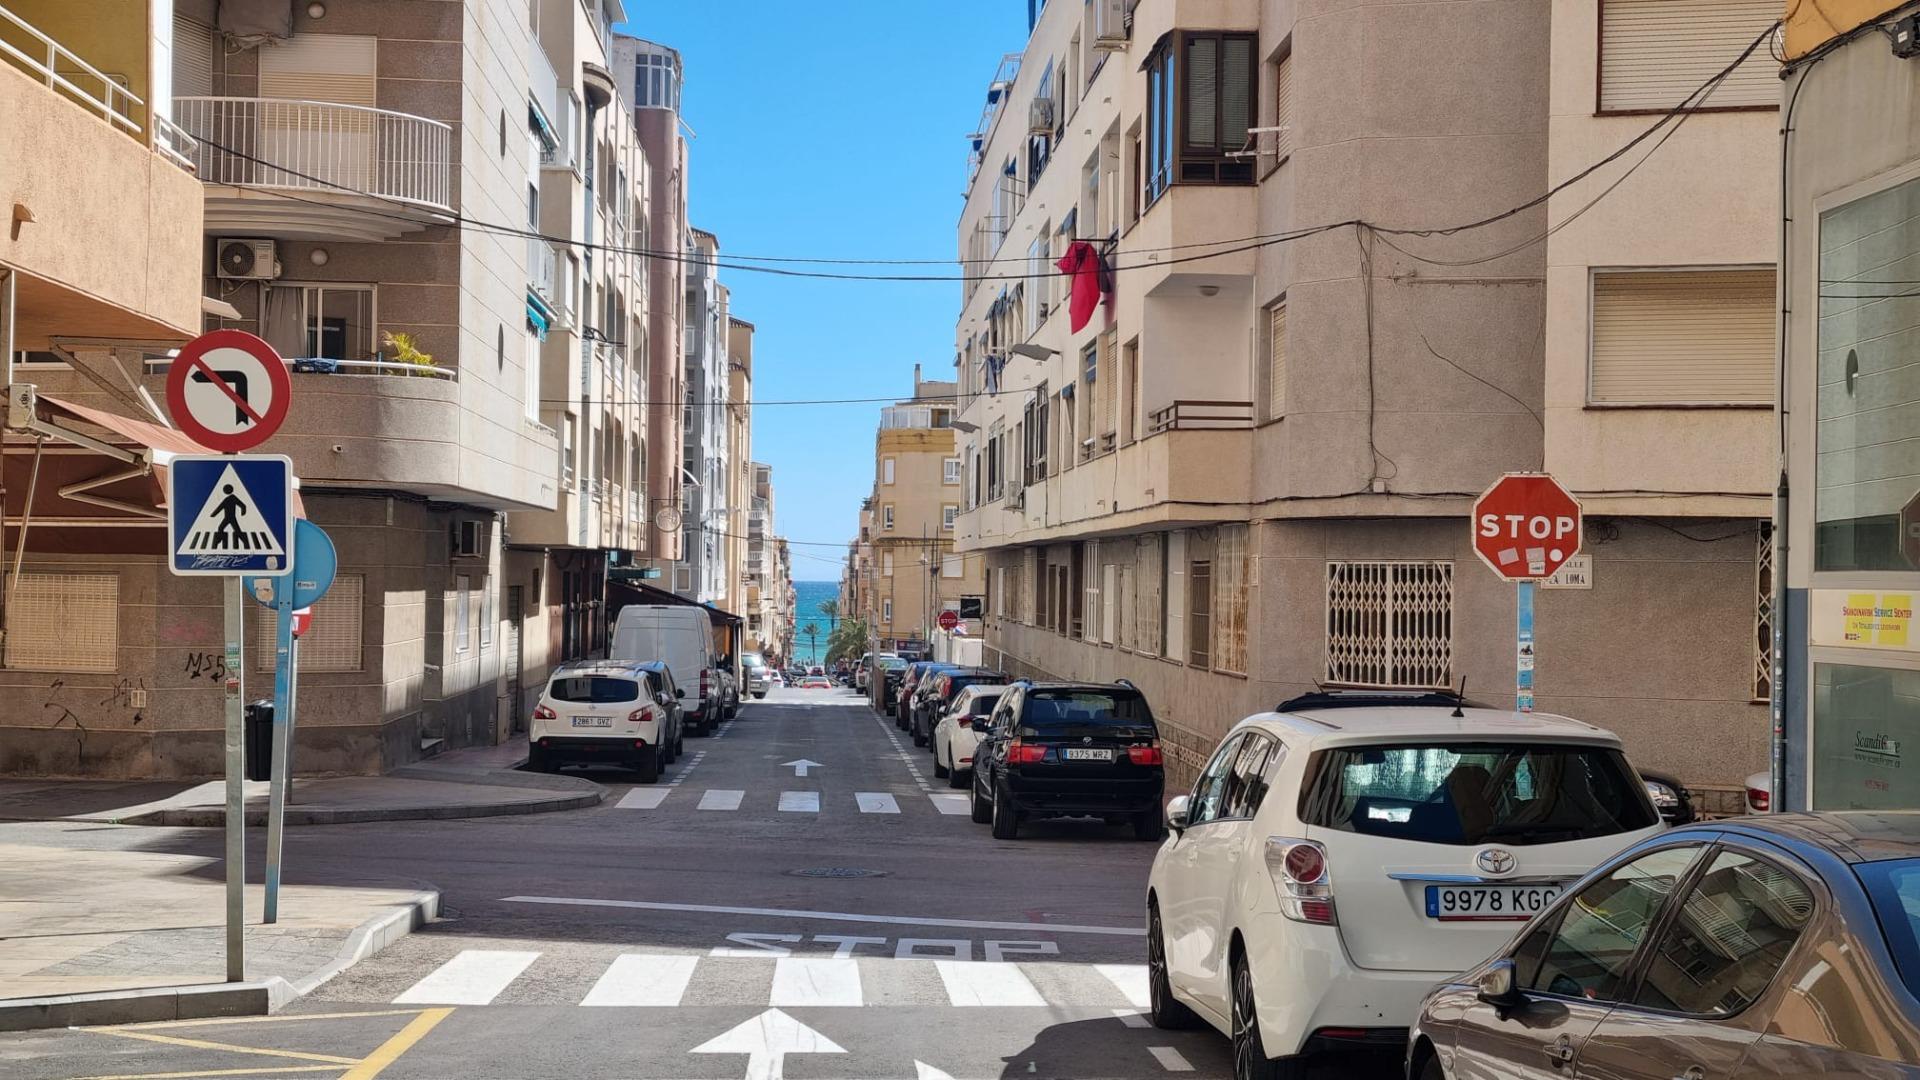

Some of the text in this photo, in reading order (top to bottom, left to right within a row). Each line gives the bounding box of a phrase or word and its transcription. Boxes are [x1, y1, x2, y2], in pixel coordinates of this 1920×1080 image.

[1480, 513, 1575, 540] STOP
[1565, 573, 1586, 584] LOMA
[1069, 749, 1110, 760] 9375 MRZ
[1443, 890, 1503, 911] 9978
[709, 932, 1061, 962] STOP
